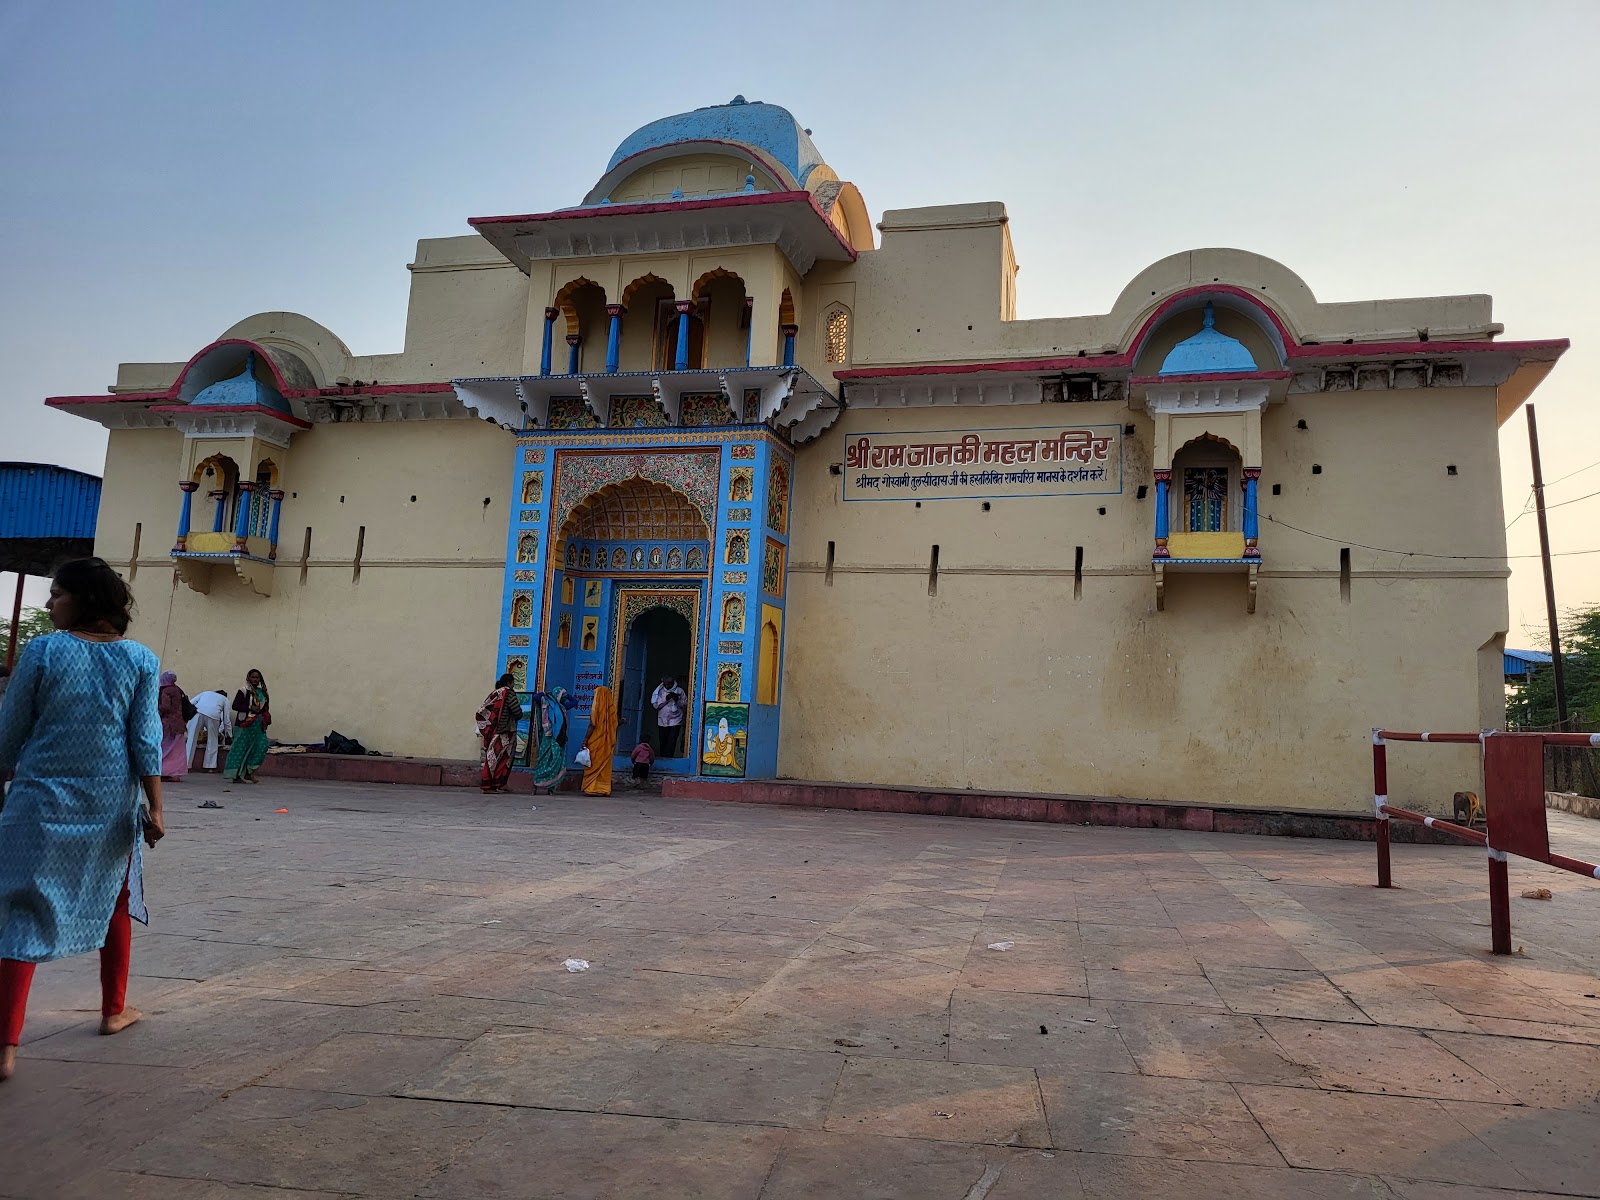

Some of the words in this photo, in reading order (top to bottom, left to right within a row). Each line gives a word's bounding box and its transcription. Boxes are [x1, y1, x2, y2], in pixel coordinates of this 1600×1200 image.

[907, 434, 982, 468] जानकी
[983, 440, 1041, 466] महल
[1041, 430, 1114, 465] मन्दिर
[882, 472, 910, 488] गोस्वामी
[910, 472, 948, 491] तुलसीदास
[948, 470, 959, 486] जी
[959, 471, 968, 485] की
[969, 470, 1004, 487] हस्तलिखित
[1004, 468, 1035, 485] रामचरित
[1036, 471, 1060, 484] मानस
[1060, 467, 1067, 482] के
[1067, 467, 1089, 484] दर्शन
